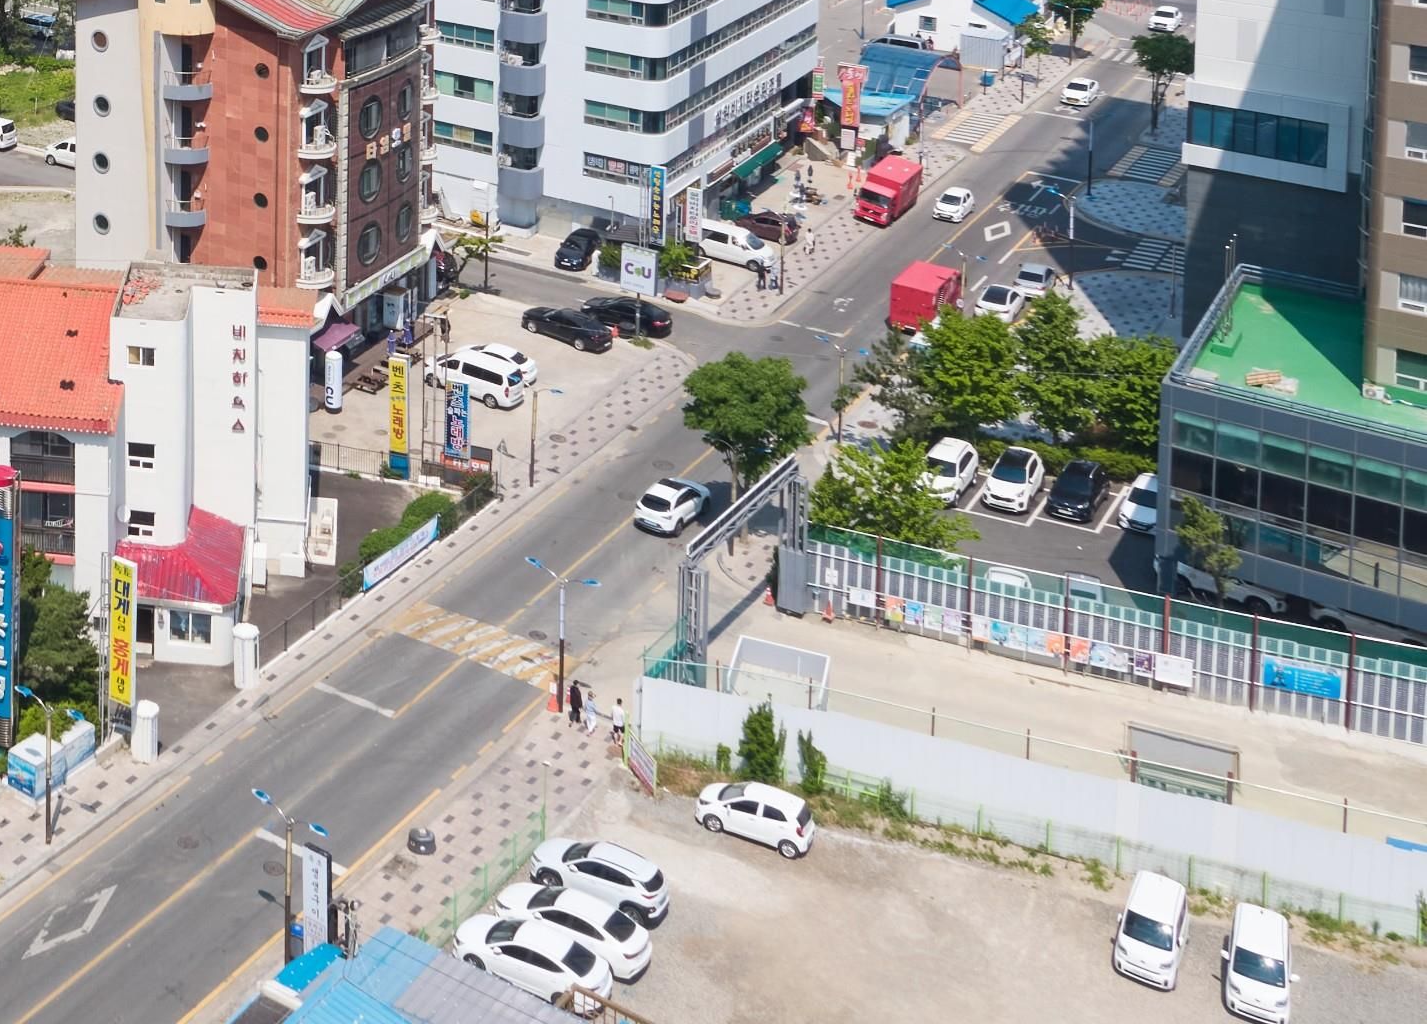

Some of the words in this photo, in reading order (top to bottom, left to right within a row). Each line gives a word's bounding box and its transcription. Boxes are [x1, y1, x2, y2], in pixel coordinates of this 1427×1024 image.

[231, 324, 249, 433] 비치하우스
[325, 386, 334, 406] CU
[392, 404, 405, 440] 노래방
[450, 416, 465, 451] 노래방
[113, 578, 131, 617] 대게
[112, 637, 130, 677] 홍게
